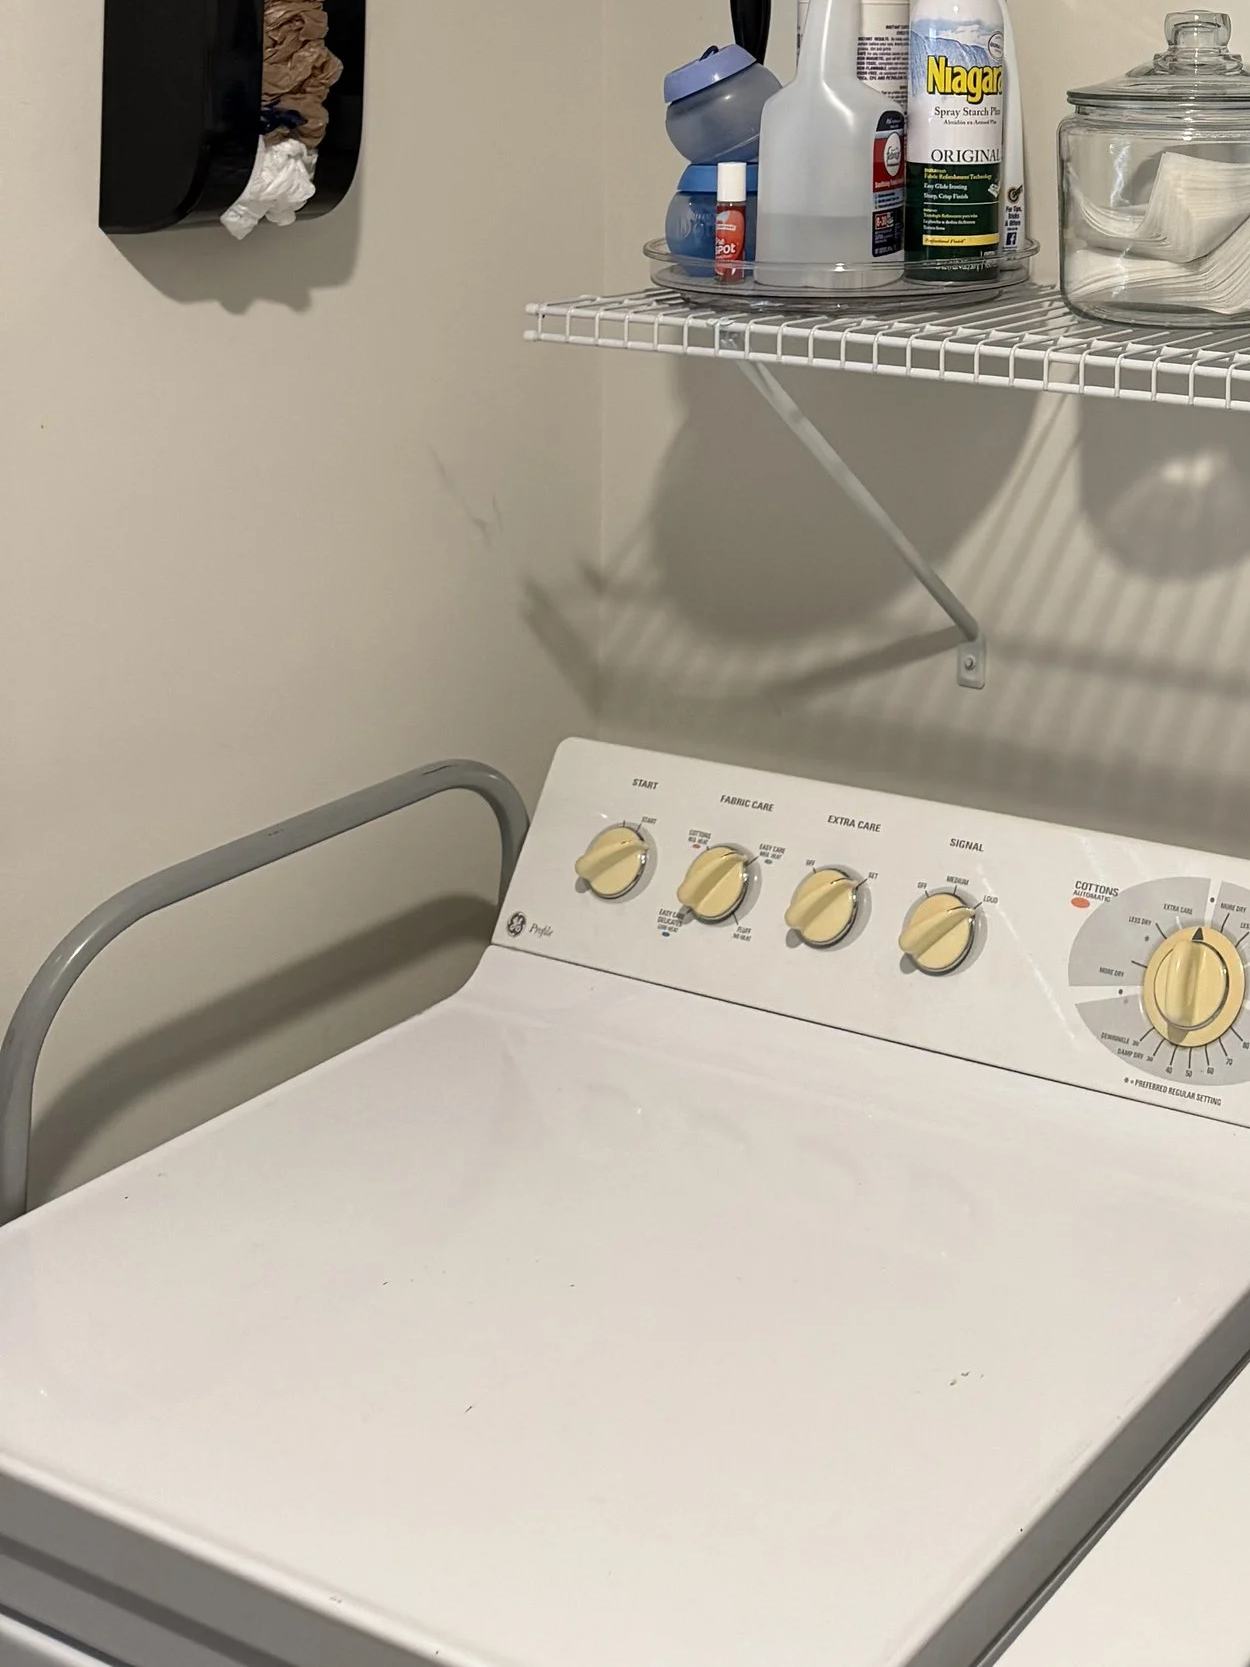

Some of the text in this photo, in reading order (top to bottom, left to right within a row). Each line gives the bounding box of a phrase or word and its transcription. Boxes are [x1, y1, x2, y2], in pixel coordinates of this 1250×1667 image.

[934, 106, 989, 119] Spray Starch
[930, 148, 1000, 163] ORIGINAL
[632, 777, 659, 790] START
[720, 794, 775, 812] FABRIC CARE
[827, 814, 881, 832] EXTRA CARE
[950, 838, 985, 852] SIGNAL
[1075, 880, 1119, 897] COTTONS
[983, 894, 998, 904] LOUD
[1072, 889, 1111, 903] AUTOMATIC
[1163, 903, 1193, 915] EXTRA CARE
[1128, 916, 1152, 926] LESS DRY
[529, 923, 554, 938] Profile
[1225, 1058, 1233, 1066] 70
[1185, 1069, 1193, 1077] 50
[1134, 1079, 1222, 1106] PREFERRED REGULAR SETTING
